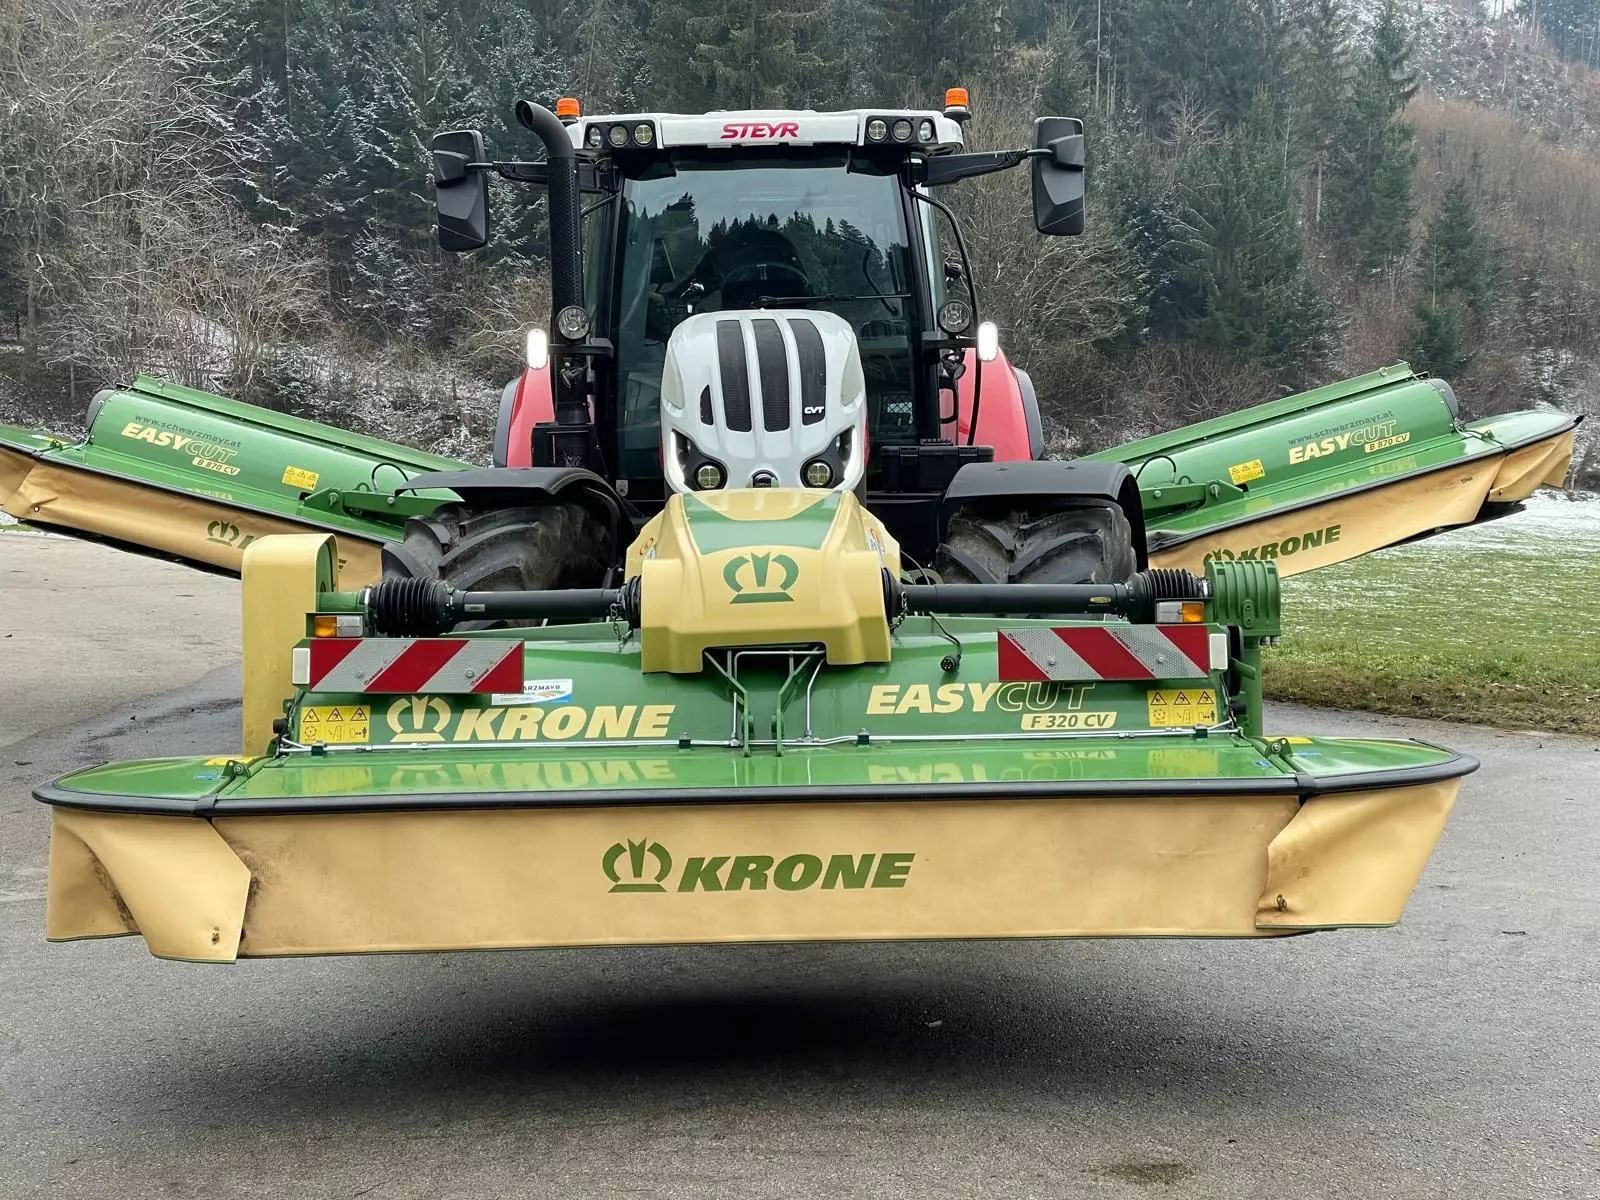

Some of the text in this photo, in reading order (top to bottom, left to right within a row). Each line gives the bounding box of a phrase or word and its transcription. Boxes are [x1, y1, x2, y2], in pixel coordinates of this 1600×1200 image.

[720, 122, 800, 139] STEYR
[804, 406, 825, 414] CVT
[121, 422, 238, 464] EASYCUT
[135, 414, 242, 448] www.schwarzmayr.at
[1288, 410, 1394, 445] www.schwarzmayr.at
[1289, 420, 1397, 465] EASYCUT
[1377, 438, 1393, 448] 870
[1395, 434, 1408, 443] CV
[205, 461, 222, 471] 870
[223, 465, 237, 474] CV
[1237, 524, 1341, 560] KRONE
[866, 682, 1096, 714] EASYCUT
[453, 704, 676, 741] KRONE
[1031, 714, 1109, 728] F 320 CV
[677, 853, 915, 892] KRONE
